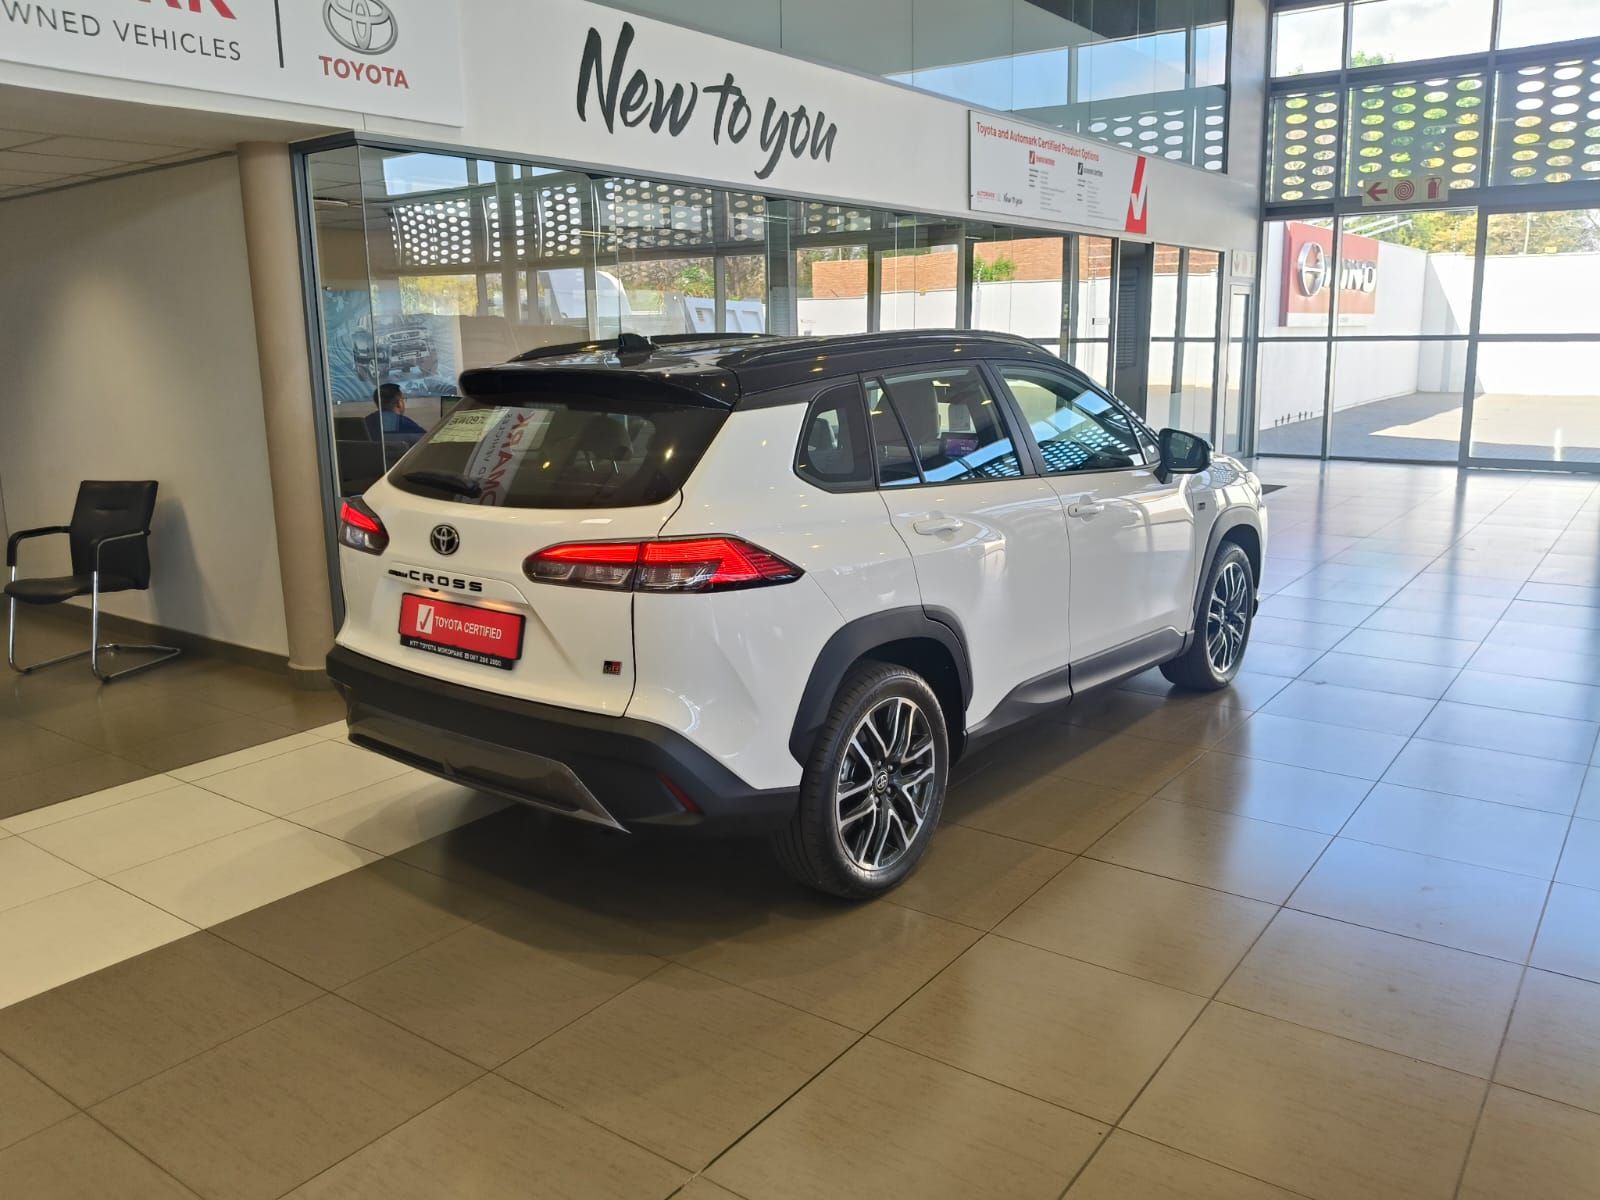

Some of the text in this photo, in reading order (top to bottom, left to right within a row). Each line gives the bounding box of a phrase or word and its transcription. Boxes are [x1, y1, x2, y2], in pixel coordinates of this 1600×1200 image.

[113, 19, 241, 61] VEHICLES
[318, 55, 410, 89] TOYOTA
[576, 21, 838, 180] New to you
[976, 121, 1099, 162] Toyota and Automark Certified Product Options
[409, 570, 482, 592] CROSS
[435, 616, 502, 640] TOYOTA CERTIFIED
[420, 642, 437, 652] TOYOTA
